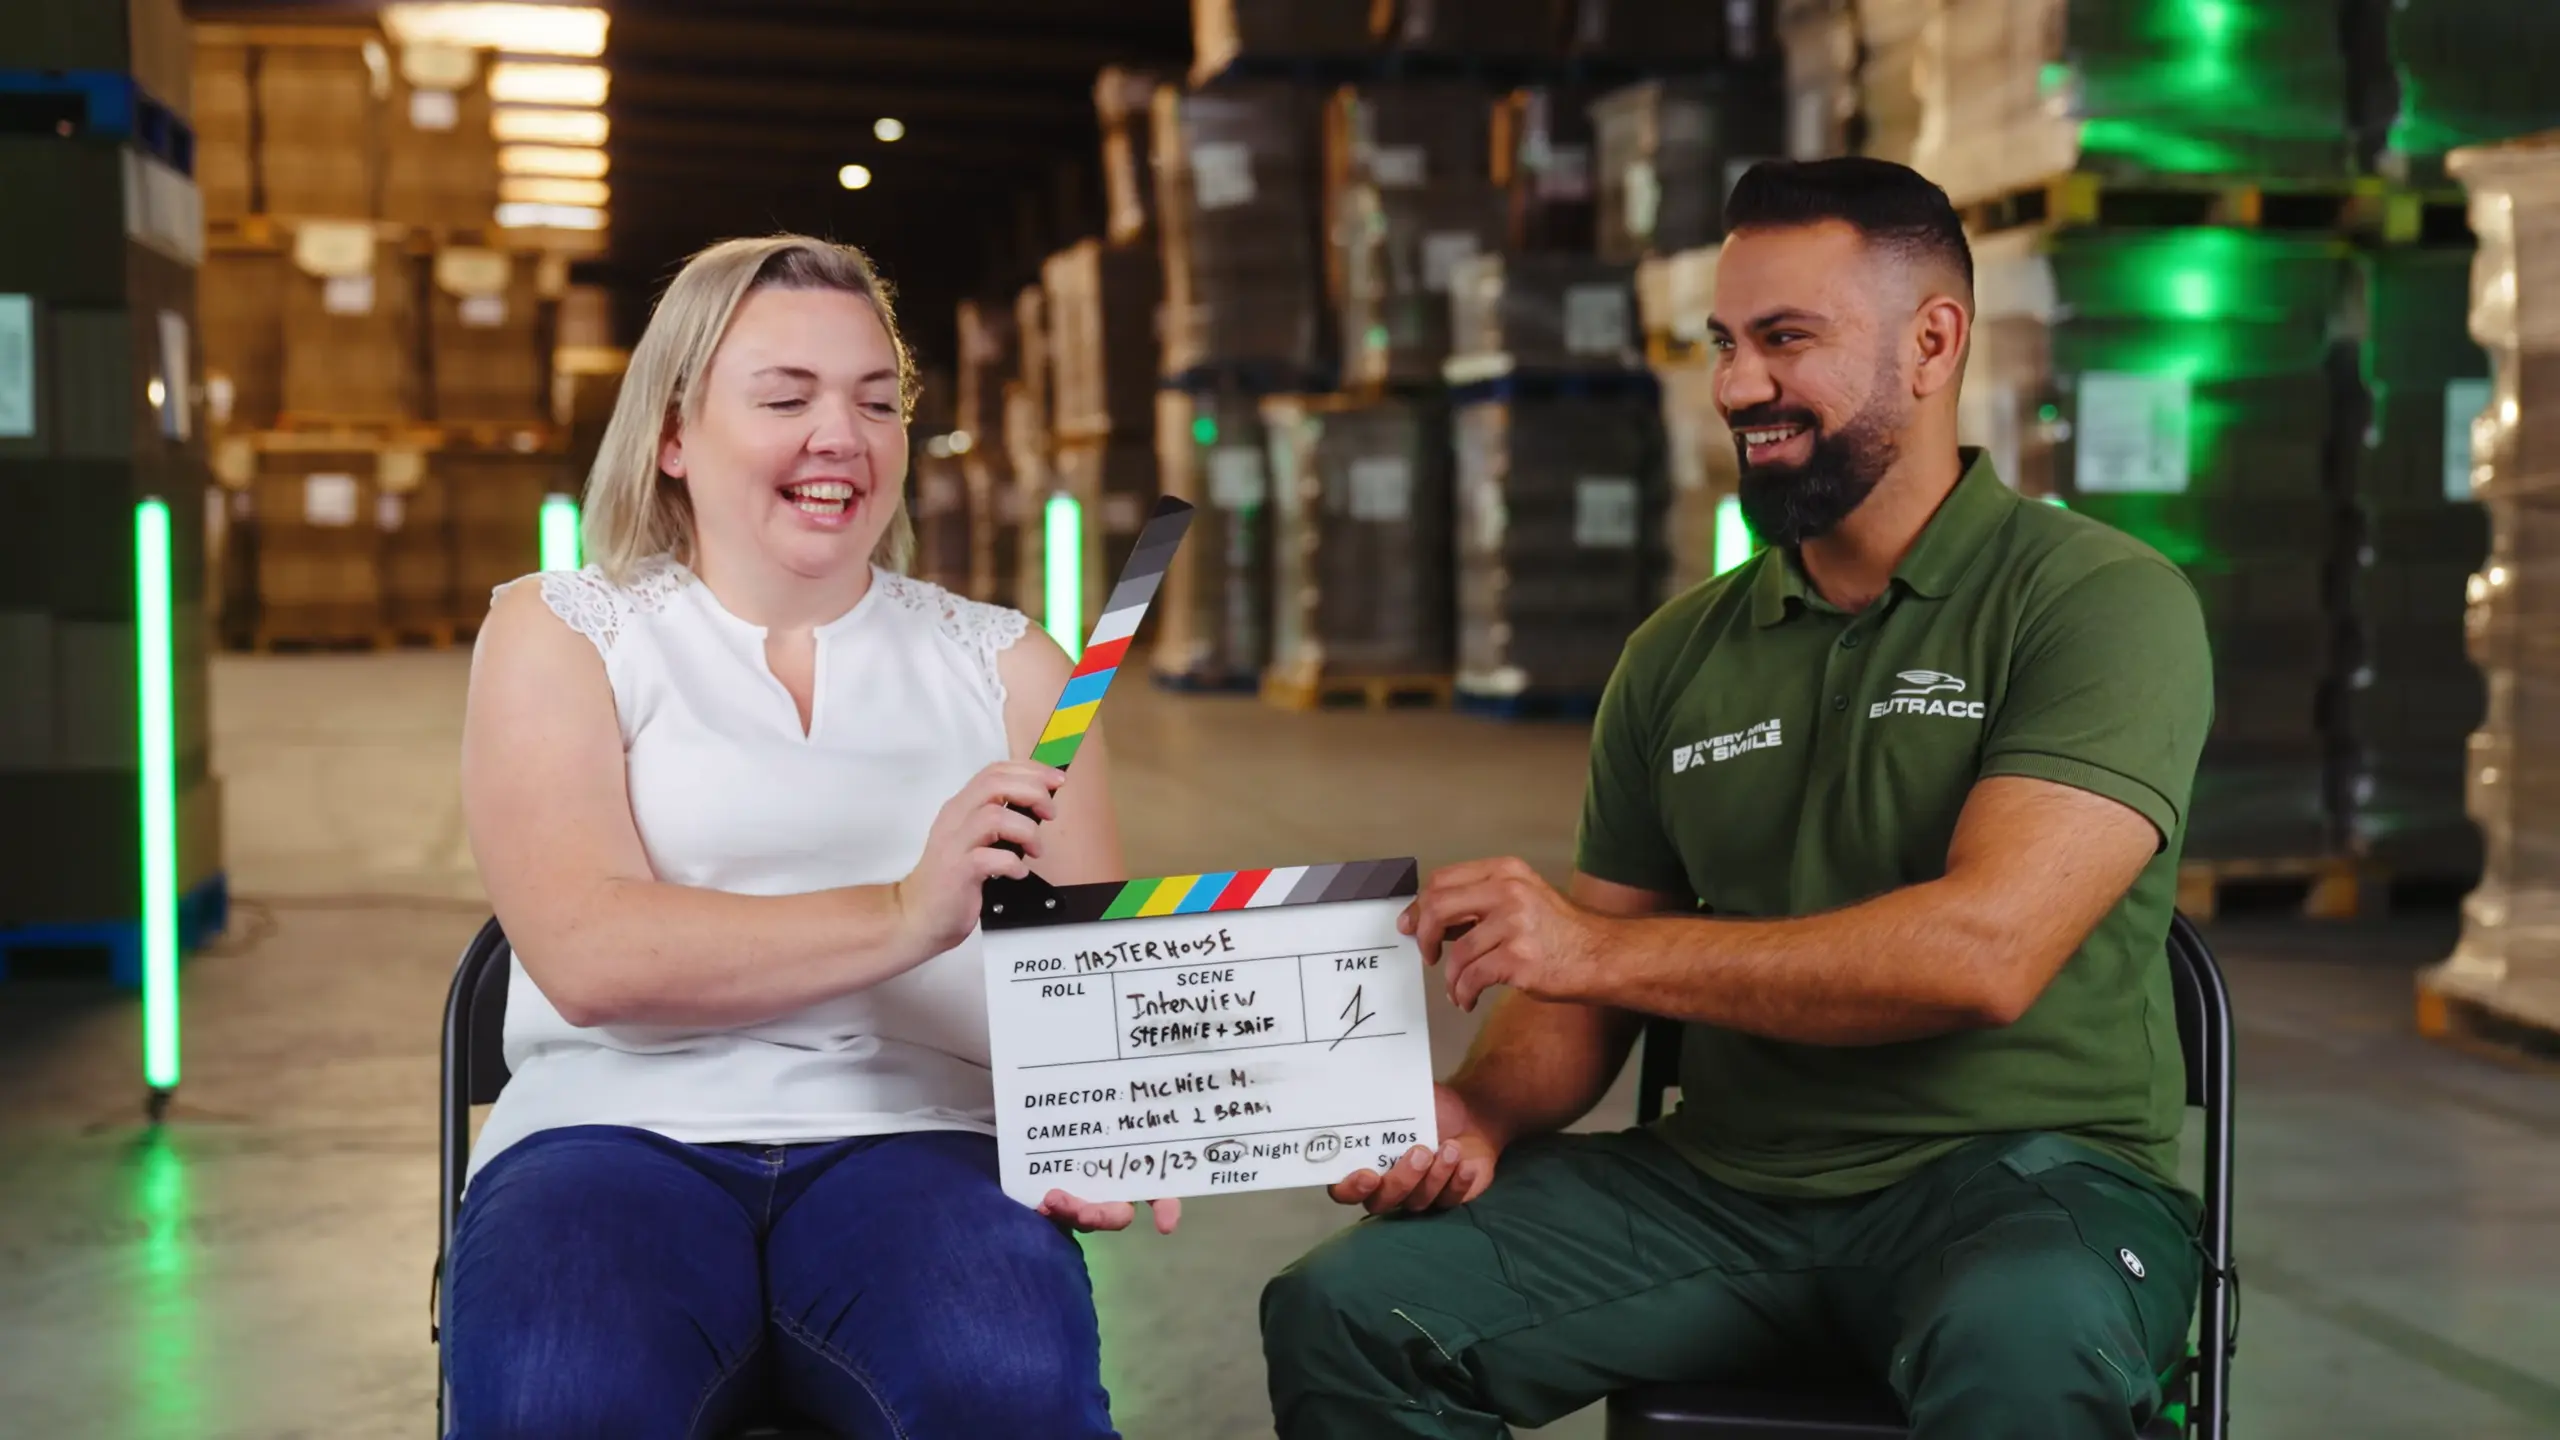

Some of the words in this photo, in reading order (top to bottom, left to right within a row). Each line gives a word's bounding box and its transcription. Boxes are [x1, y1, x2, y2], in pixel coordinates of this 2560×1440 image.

[1695, 731, 1744, 752] EVERY
[1747, 719, 1781, 737] MILE
[1690, 753, 1705, 768] A
[1713, 731, 1782, 762] SMILE
[1014, 957, 1067, 973] PROD.
[1334, 955, 1380, 972] TAKE
[1176, 969, 1235, 987] SCENE
[1041, 983, 1086, 999] ROLL
[1025, 1087, 1124, 1109] DIRECTOR:
[1230, 1068, 1256, 1089] M.
[1026, 1121, 1111, 1140] CAMERA:
[1207, 1148, 1242, 1163] Day
[1252, 1141, 1300, 1160] Night
[1309, 1139, 1334, 1153] Int
[1343, 1134, 1371, 1150] Ext
[1381, 1130, 1418, 1146] Mos
[1028, 1158, 1082, 1176] DATE:
[1376, 1152, 1404, 1171] Sy
[1210, 1169, 1259, 1186] Filter
